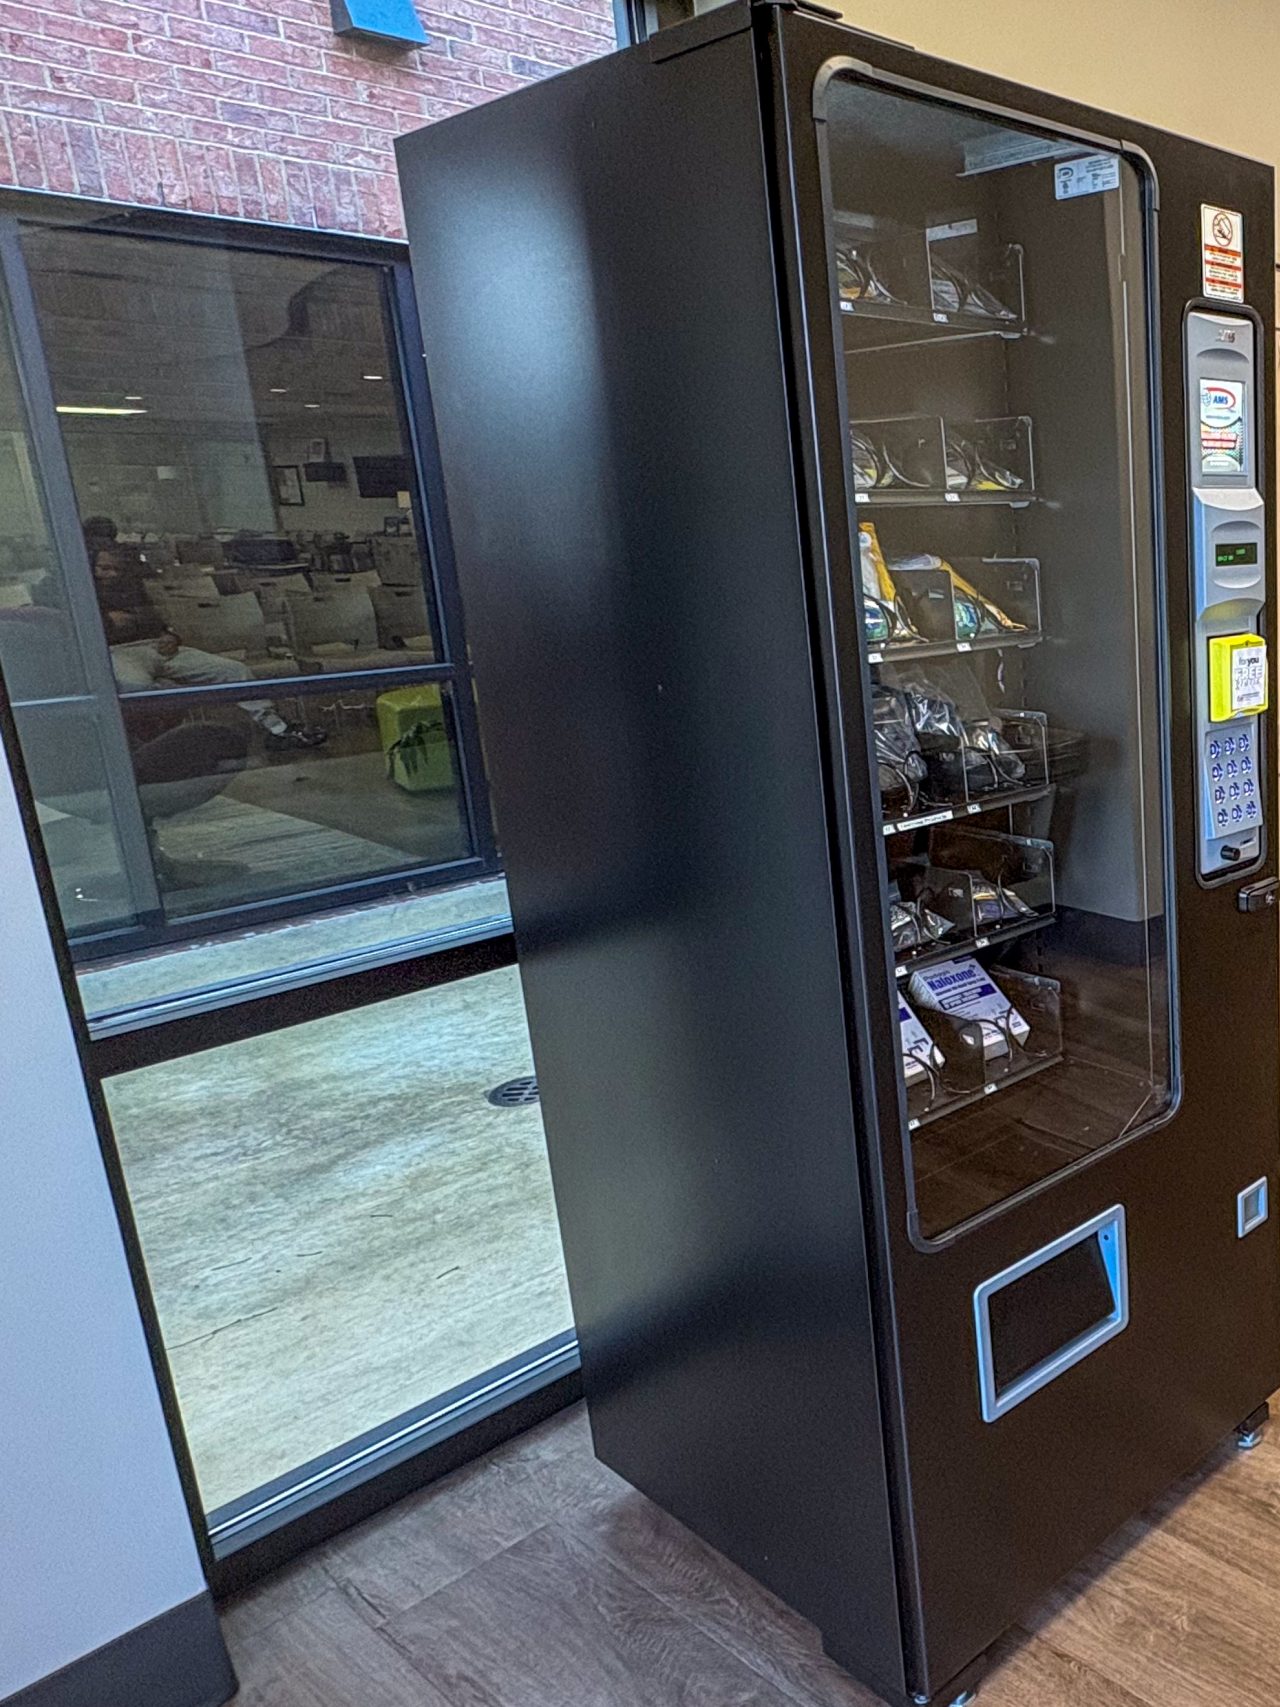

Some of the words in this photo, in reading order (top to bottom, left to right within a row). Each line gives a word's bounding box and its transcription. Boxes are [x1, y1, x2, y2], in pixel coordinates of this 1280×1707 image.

[1212, 395, 1229, 405] AMS
[1247, 656, 1260, 667] you
[927, 969, 977, 991] Naloxone
